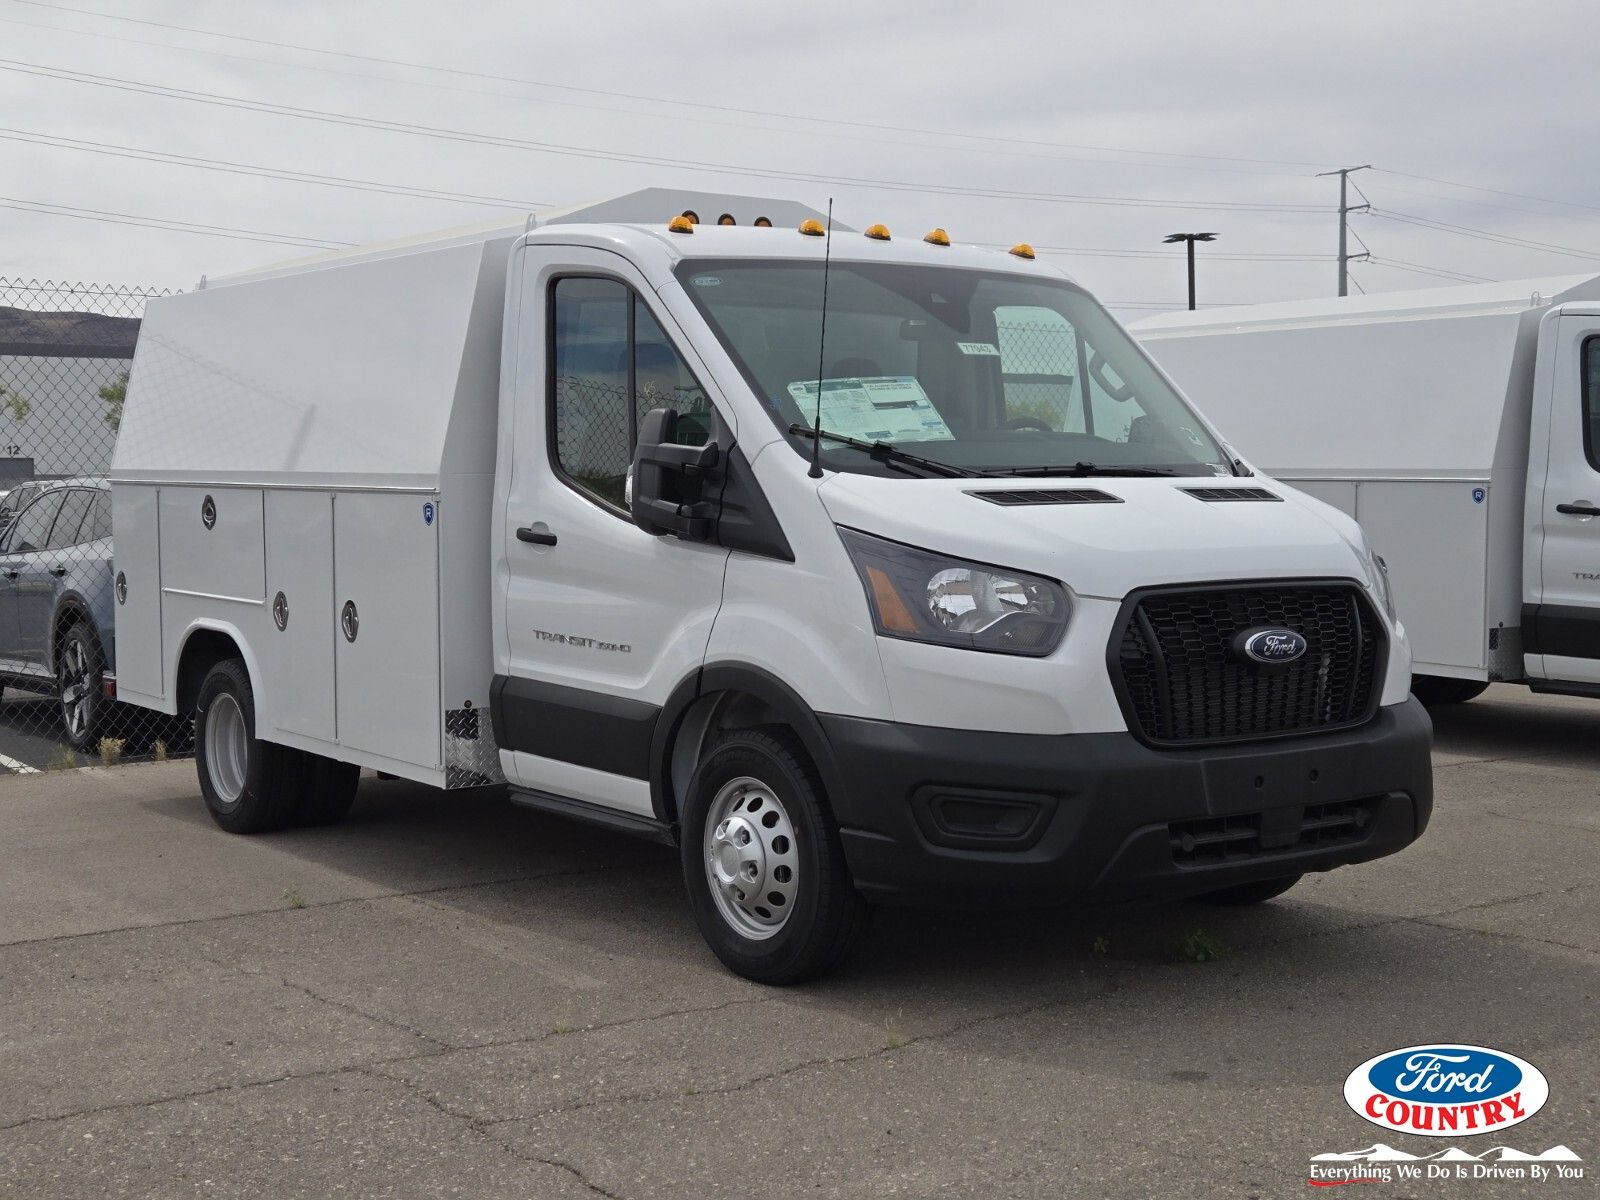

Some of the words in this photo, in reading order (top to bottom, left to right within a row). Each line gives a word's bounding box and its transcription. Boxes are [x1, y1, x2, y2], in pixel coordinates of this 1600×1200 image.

[7, 445, 20, 455] 12
[532, 629, 596, 648] TRANSIT
[1263, 635, 1297, 656] Ford
